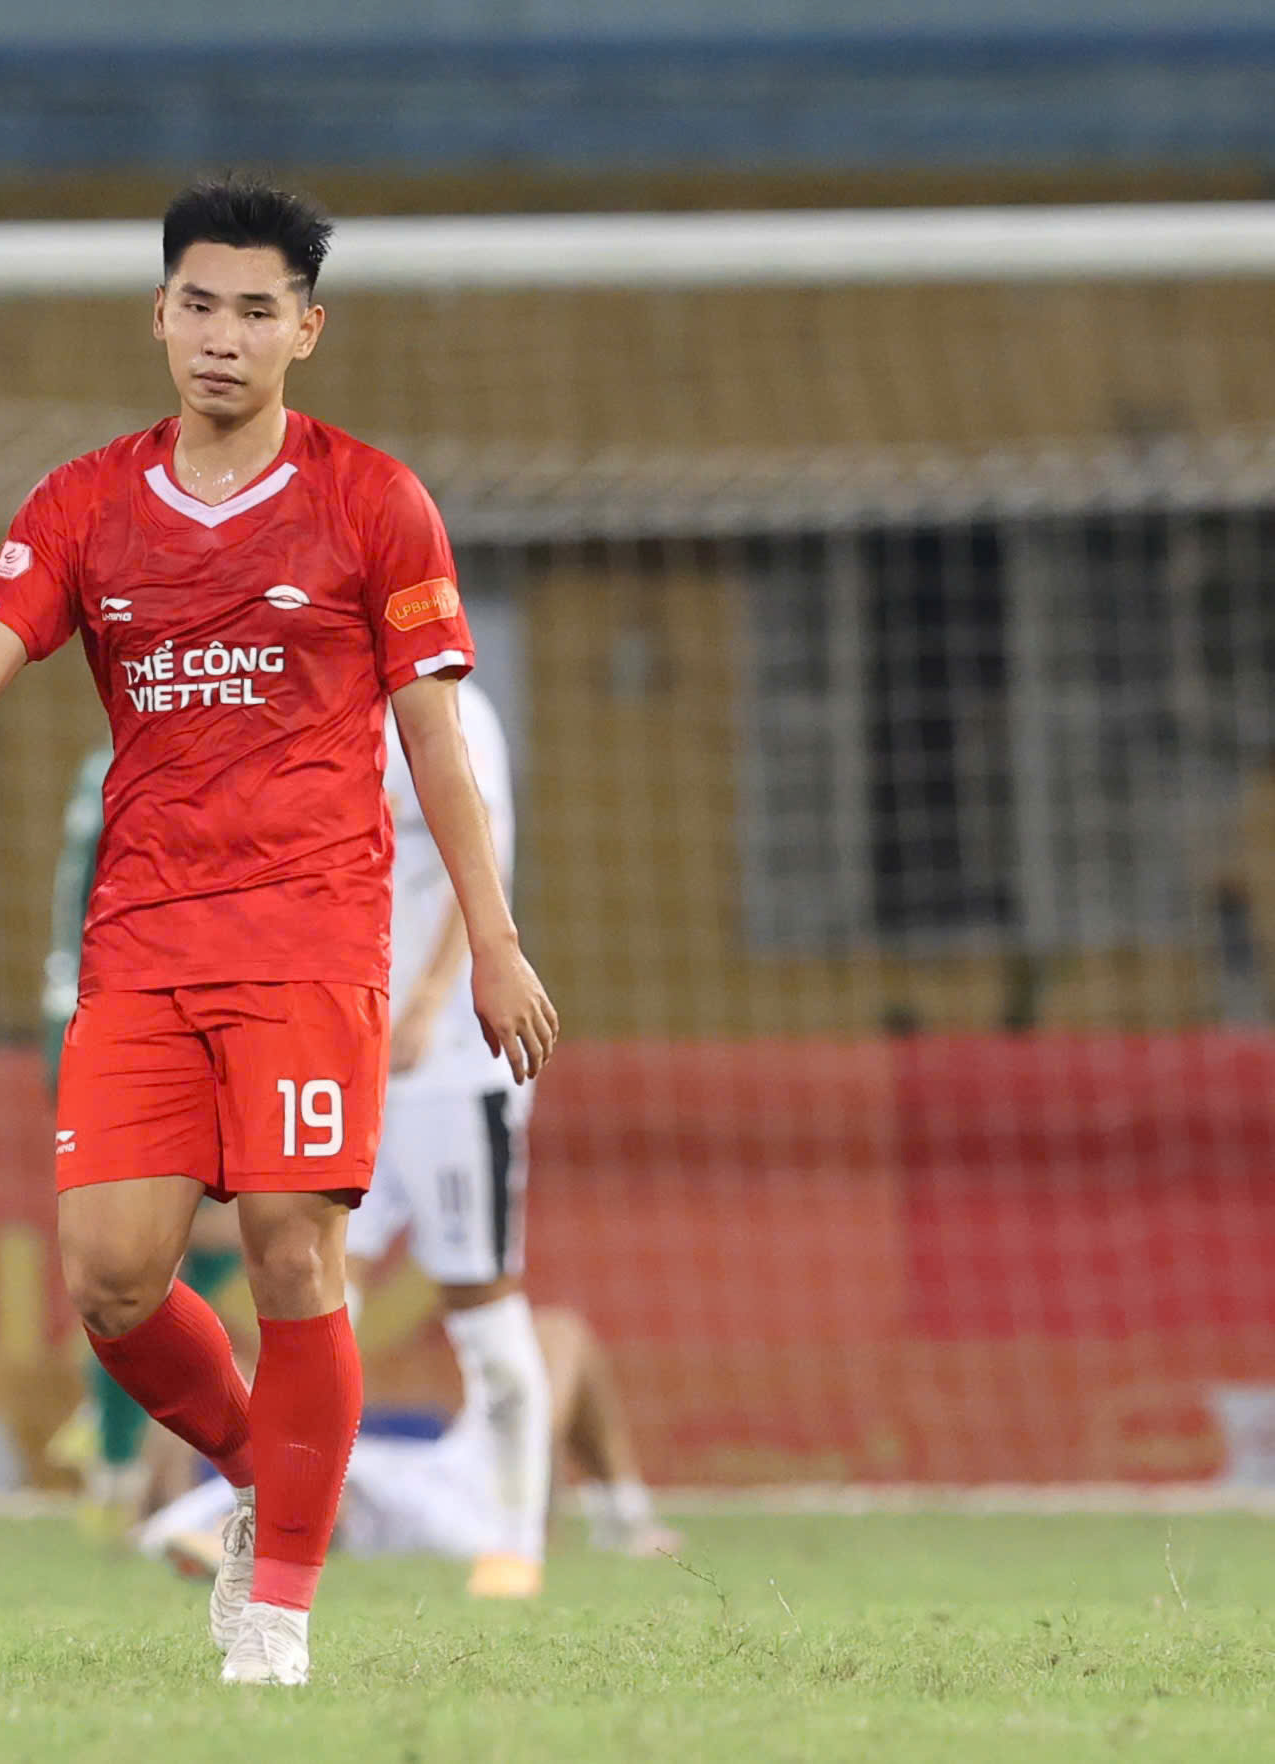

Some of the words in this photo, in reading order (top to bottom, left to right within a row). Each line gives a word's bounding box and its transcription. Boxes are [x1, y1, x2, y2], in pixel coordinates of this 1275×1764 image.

[121, 640, 174, 685] THỂ
[183, 641, 285, 678] CÔNG
[125, 678, 266, 712] VIETTEL
[277, 1079, 344, 1157] 19
